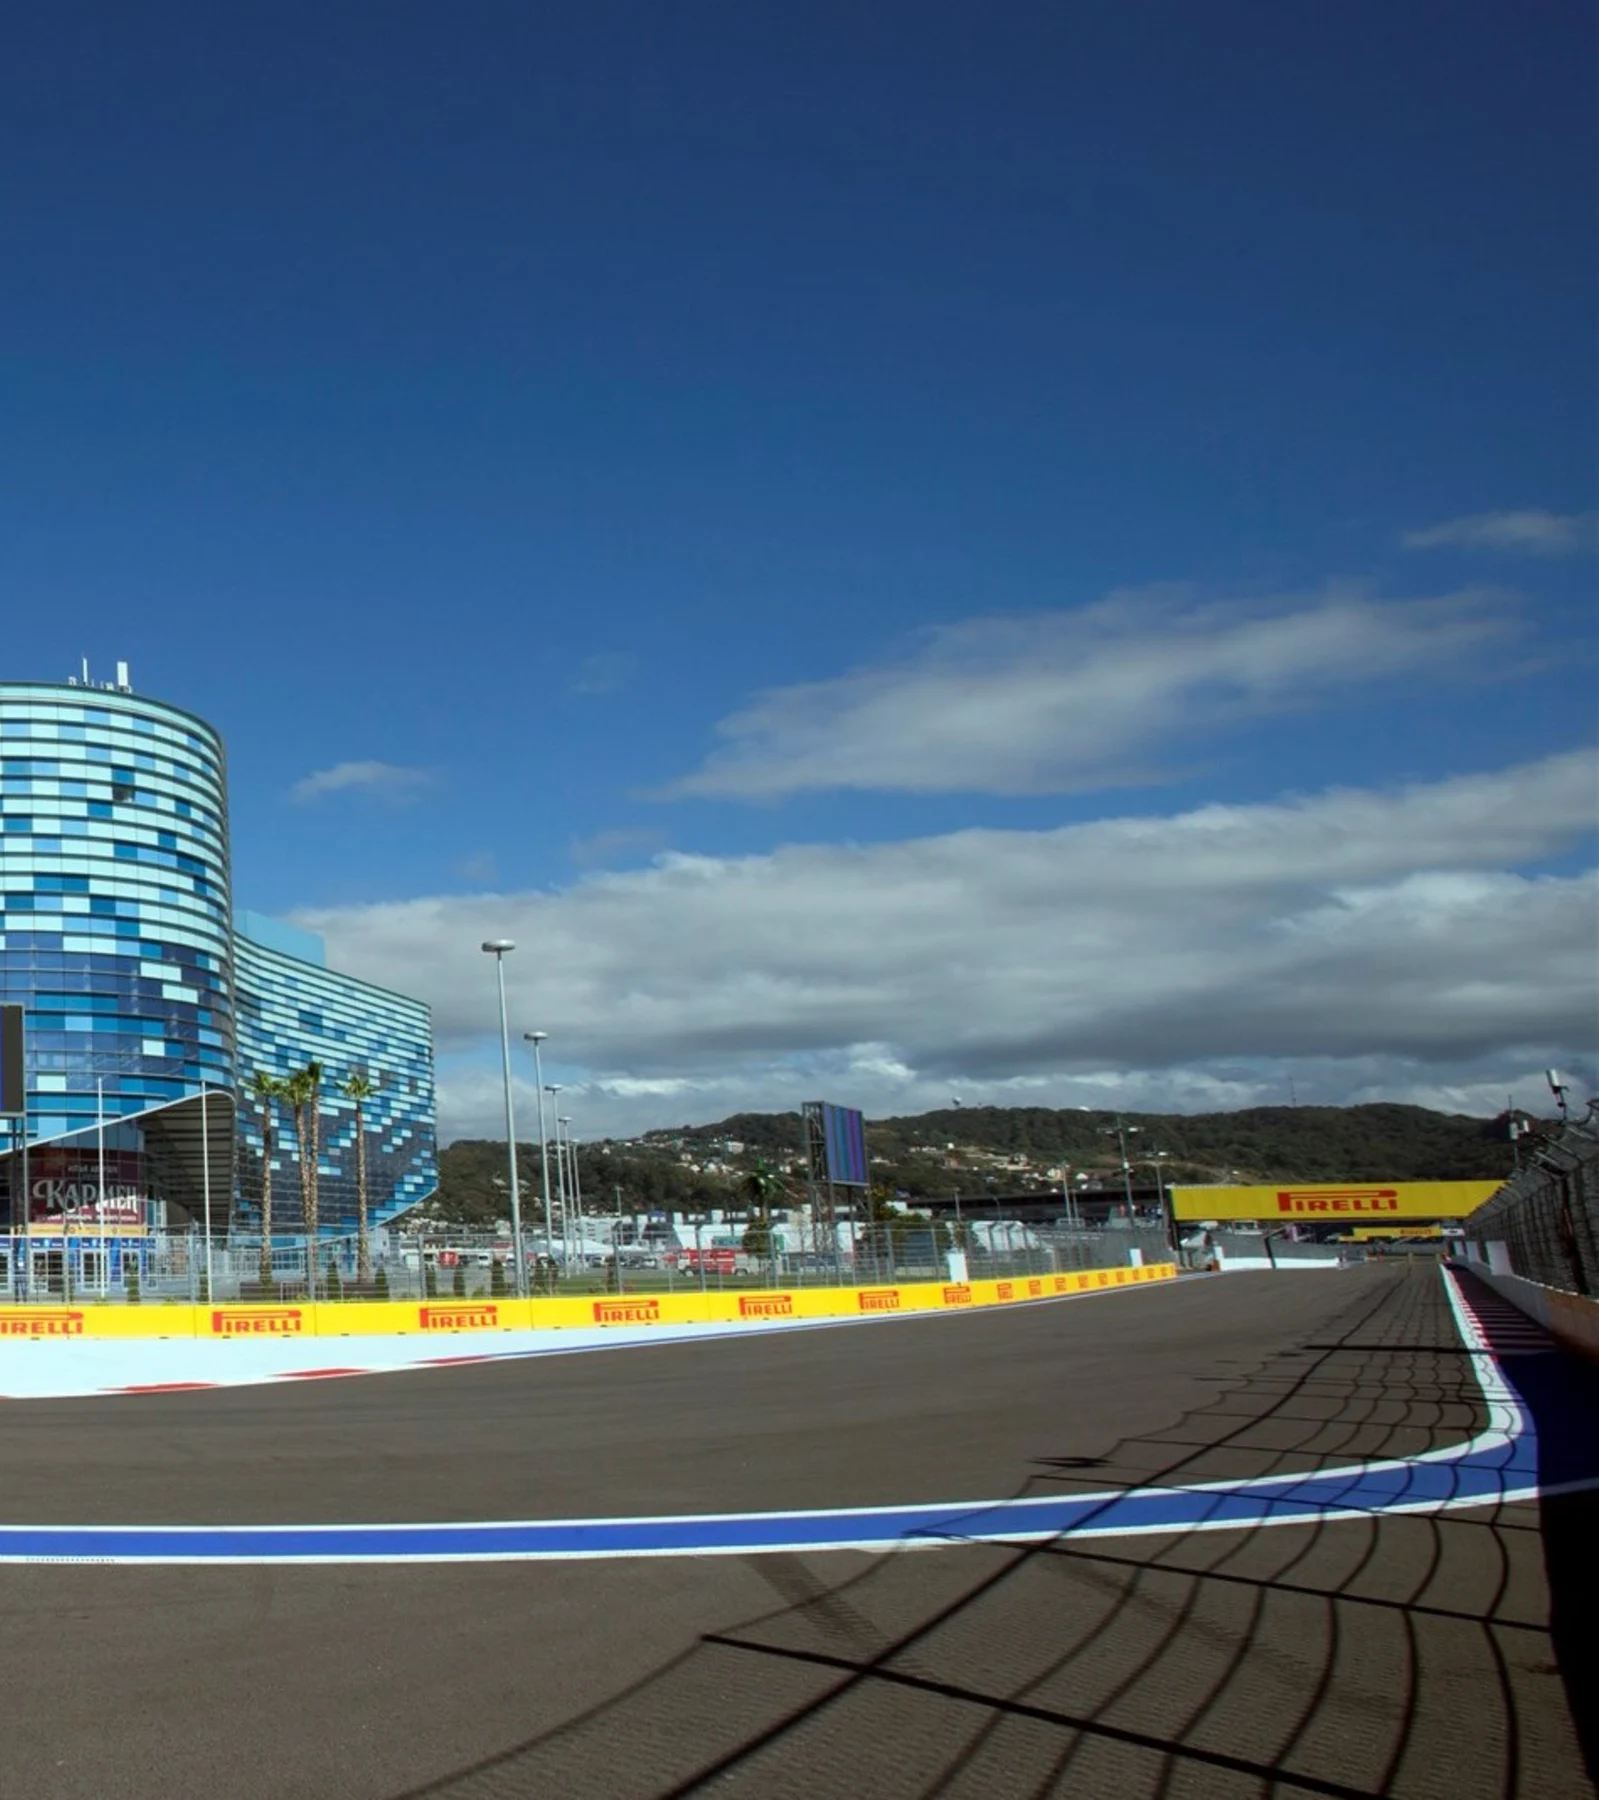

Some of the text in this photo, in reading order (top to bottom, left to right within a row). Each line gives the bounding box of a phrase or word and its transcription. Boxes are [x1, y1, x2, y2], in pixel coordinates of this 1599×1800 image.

[1277, 1190, 1397, 1212] PIRELLI
[739, 1295, 793, 1315] PIRELLI
[858, 1290, 900, 1309] PIRELLI
[419, 1306, 498, 1328] PIRELLI
[593, 1300, 660, 1321] PIRELLI
[211, 1310, 302, 1333] PIRELLI
